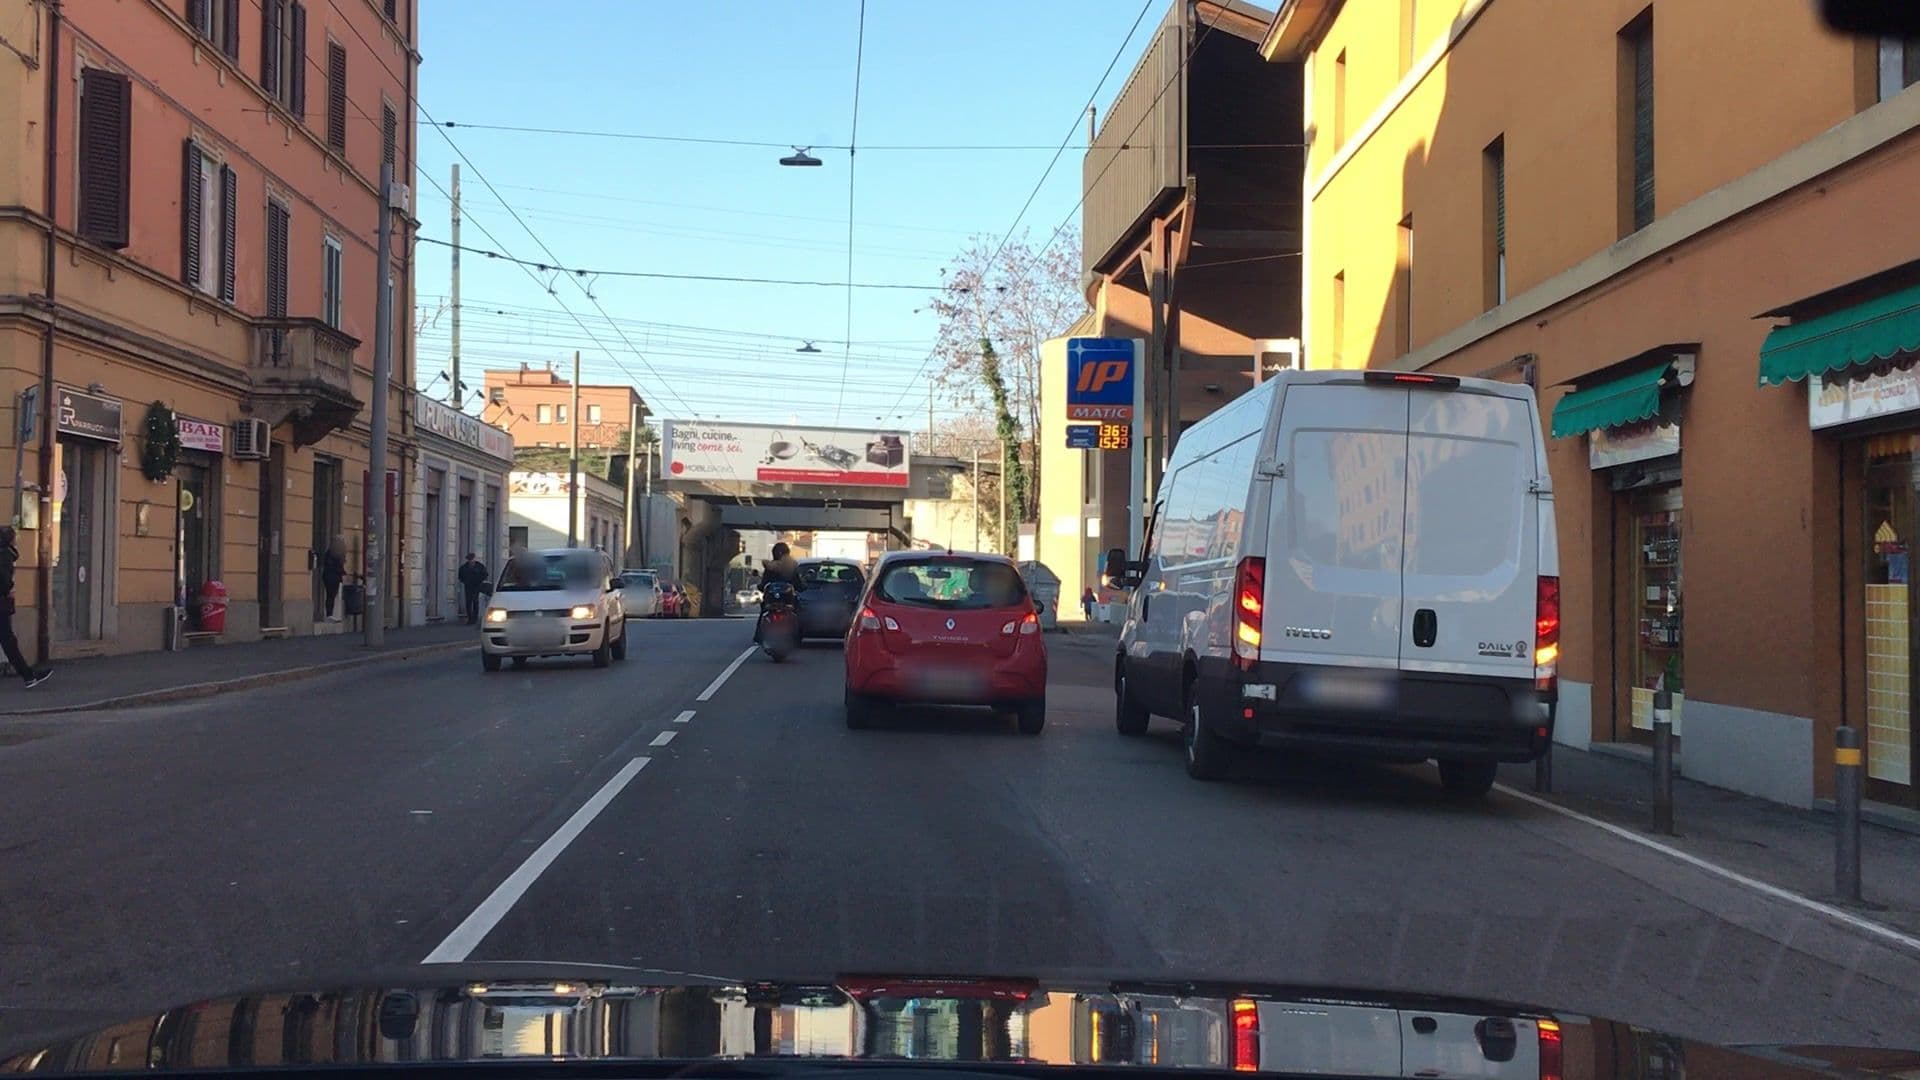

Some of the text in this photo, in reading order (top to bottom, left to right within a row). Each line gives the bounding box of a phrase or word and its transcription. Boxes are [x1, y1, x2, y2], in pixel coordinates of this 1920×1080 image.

[1076, 361, 1128, 392] IP
[1073, 408, 1126, 418] MATIC
[181, 422, 221, 437] BAR
[672, 440, 696, 452] living
[1286, 626, 1332, 640] IVECO
[1478, 642, 1513, 651] DAILY
